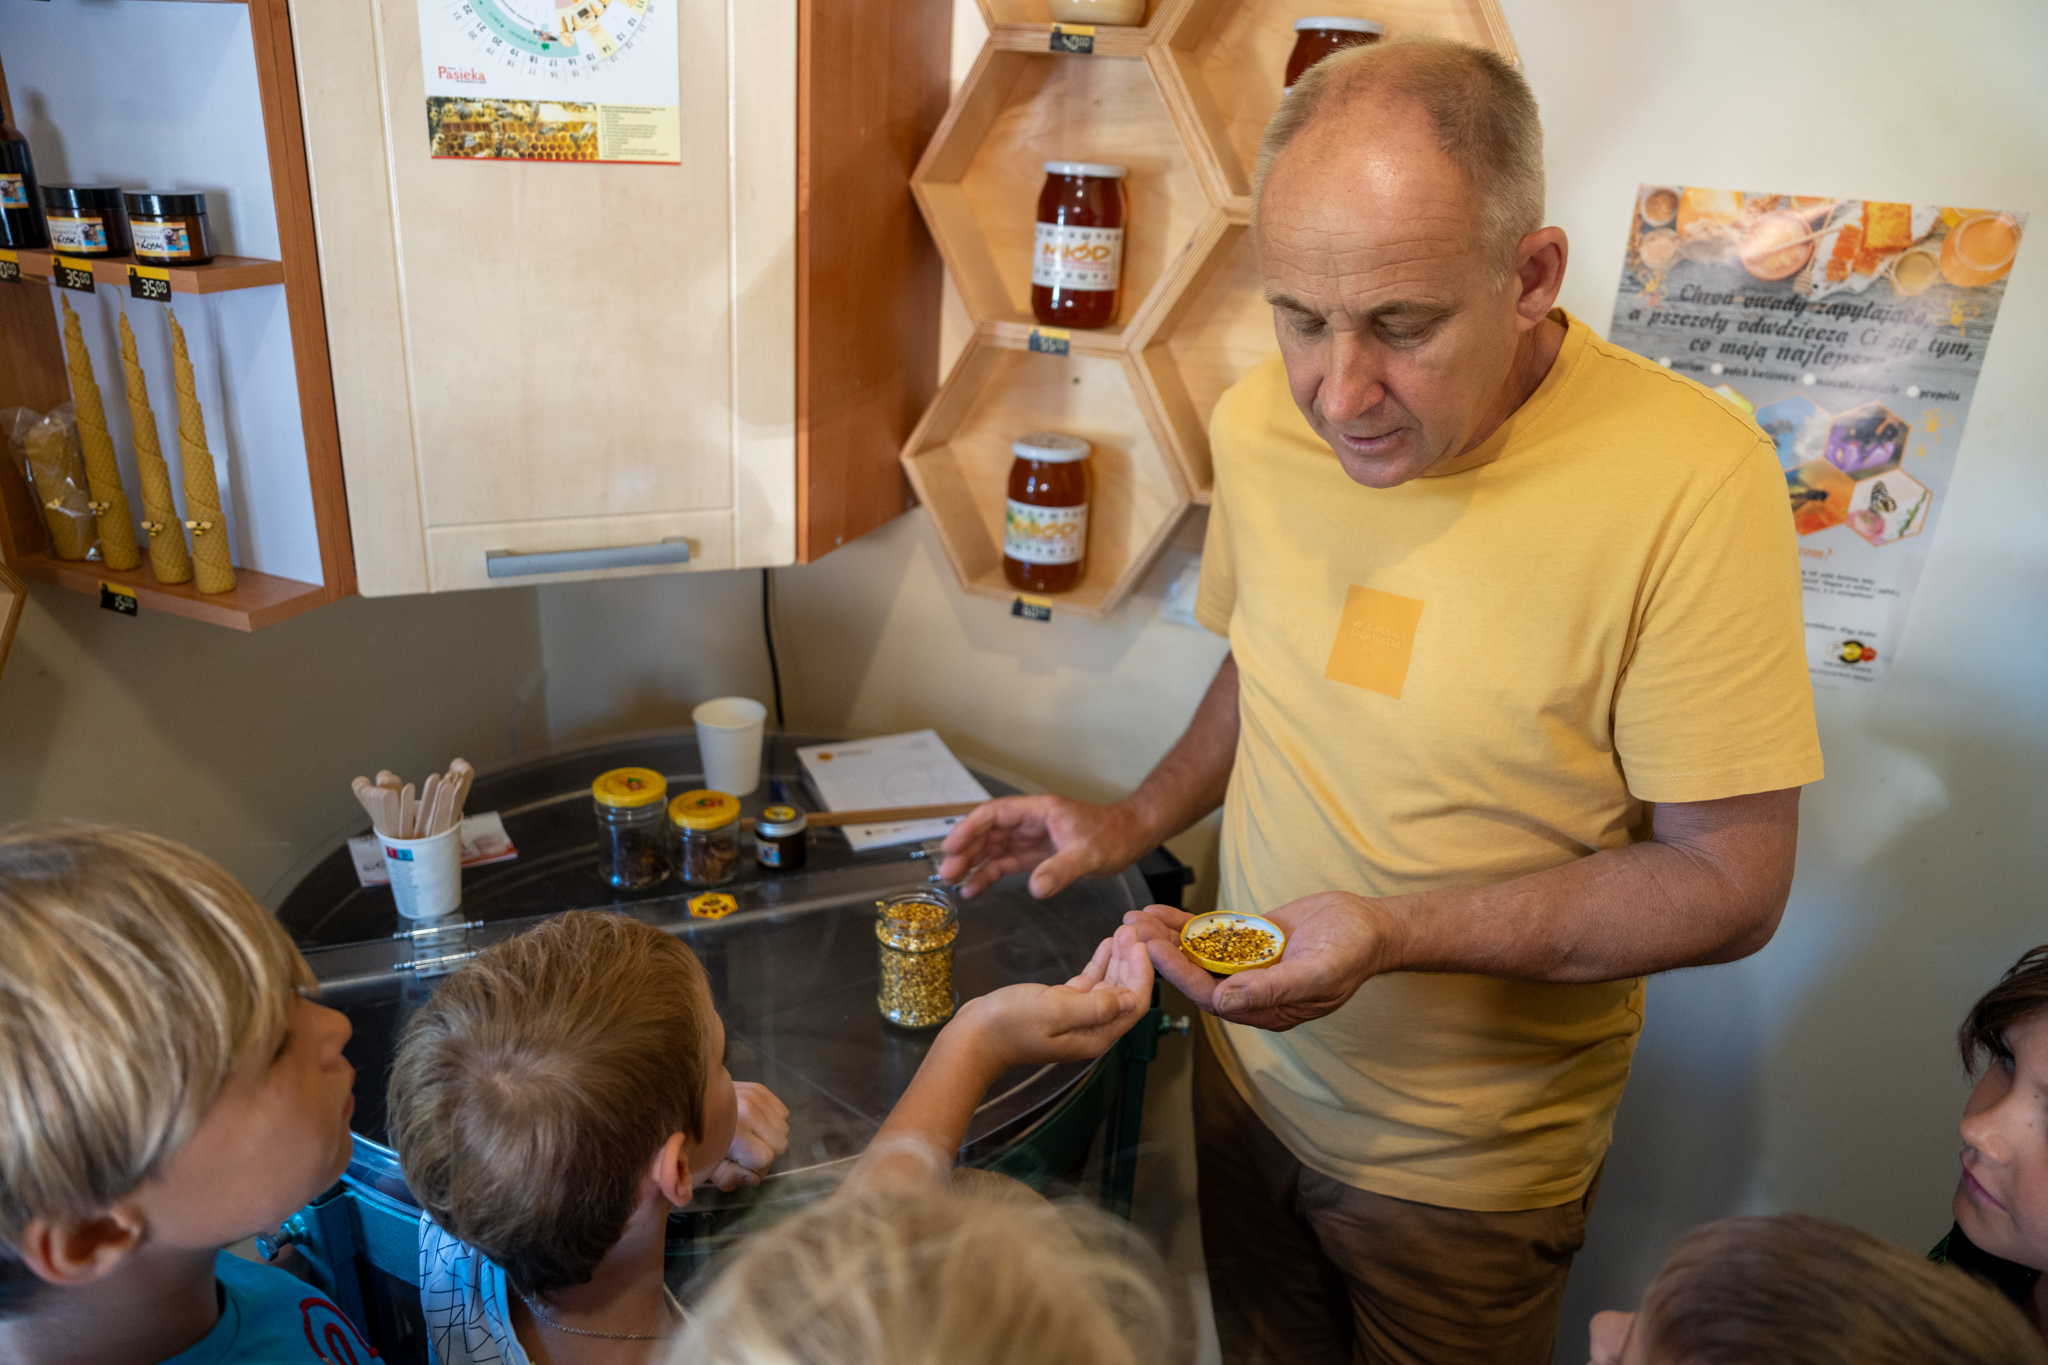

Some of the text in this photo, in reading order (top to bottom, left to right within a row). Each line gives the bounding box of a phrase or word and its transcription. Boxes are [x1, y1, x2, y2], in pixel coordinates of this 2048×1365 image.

[462, 4, 473, 15] 22
[476, 22, 487, 32] 21
[627, 16, 637, 27] 12
[492, 36, 503, 47] 20
[509, 48, 519, 57] 19
[602, 44, 612, 53] 14
[529, 55, 538, 64] 18
[549, 59, 558, 67] 17
[568, 58, 577, 66] 16
[438, 65, 486, 81] Pasieka
[1744, 294, 1807, 317] owady
[1628, 308, 1973, 362] a pszczoły odwdzięczą Ci się tym,
[1688, 338, 1711, 352] co
[1719, 340, 1768, 365] mają
[1366, 622, 1401, 639] SURVIVAL
[1350, 628, 1401, 648] SPORTSWEAR
